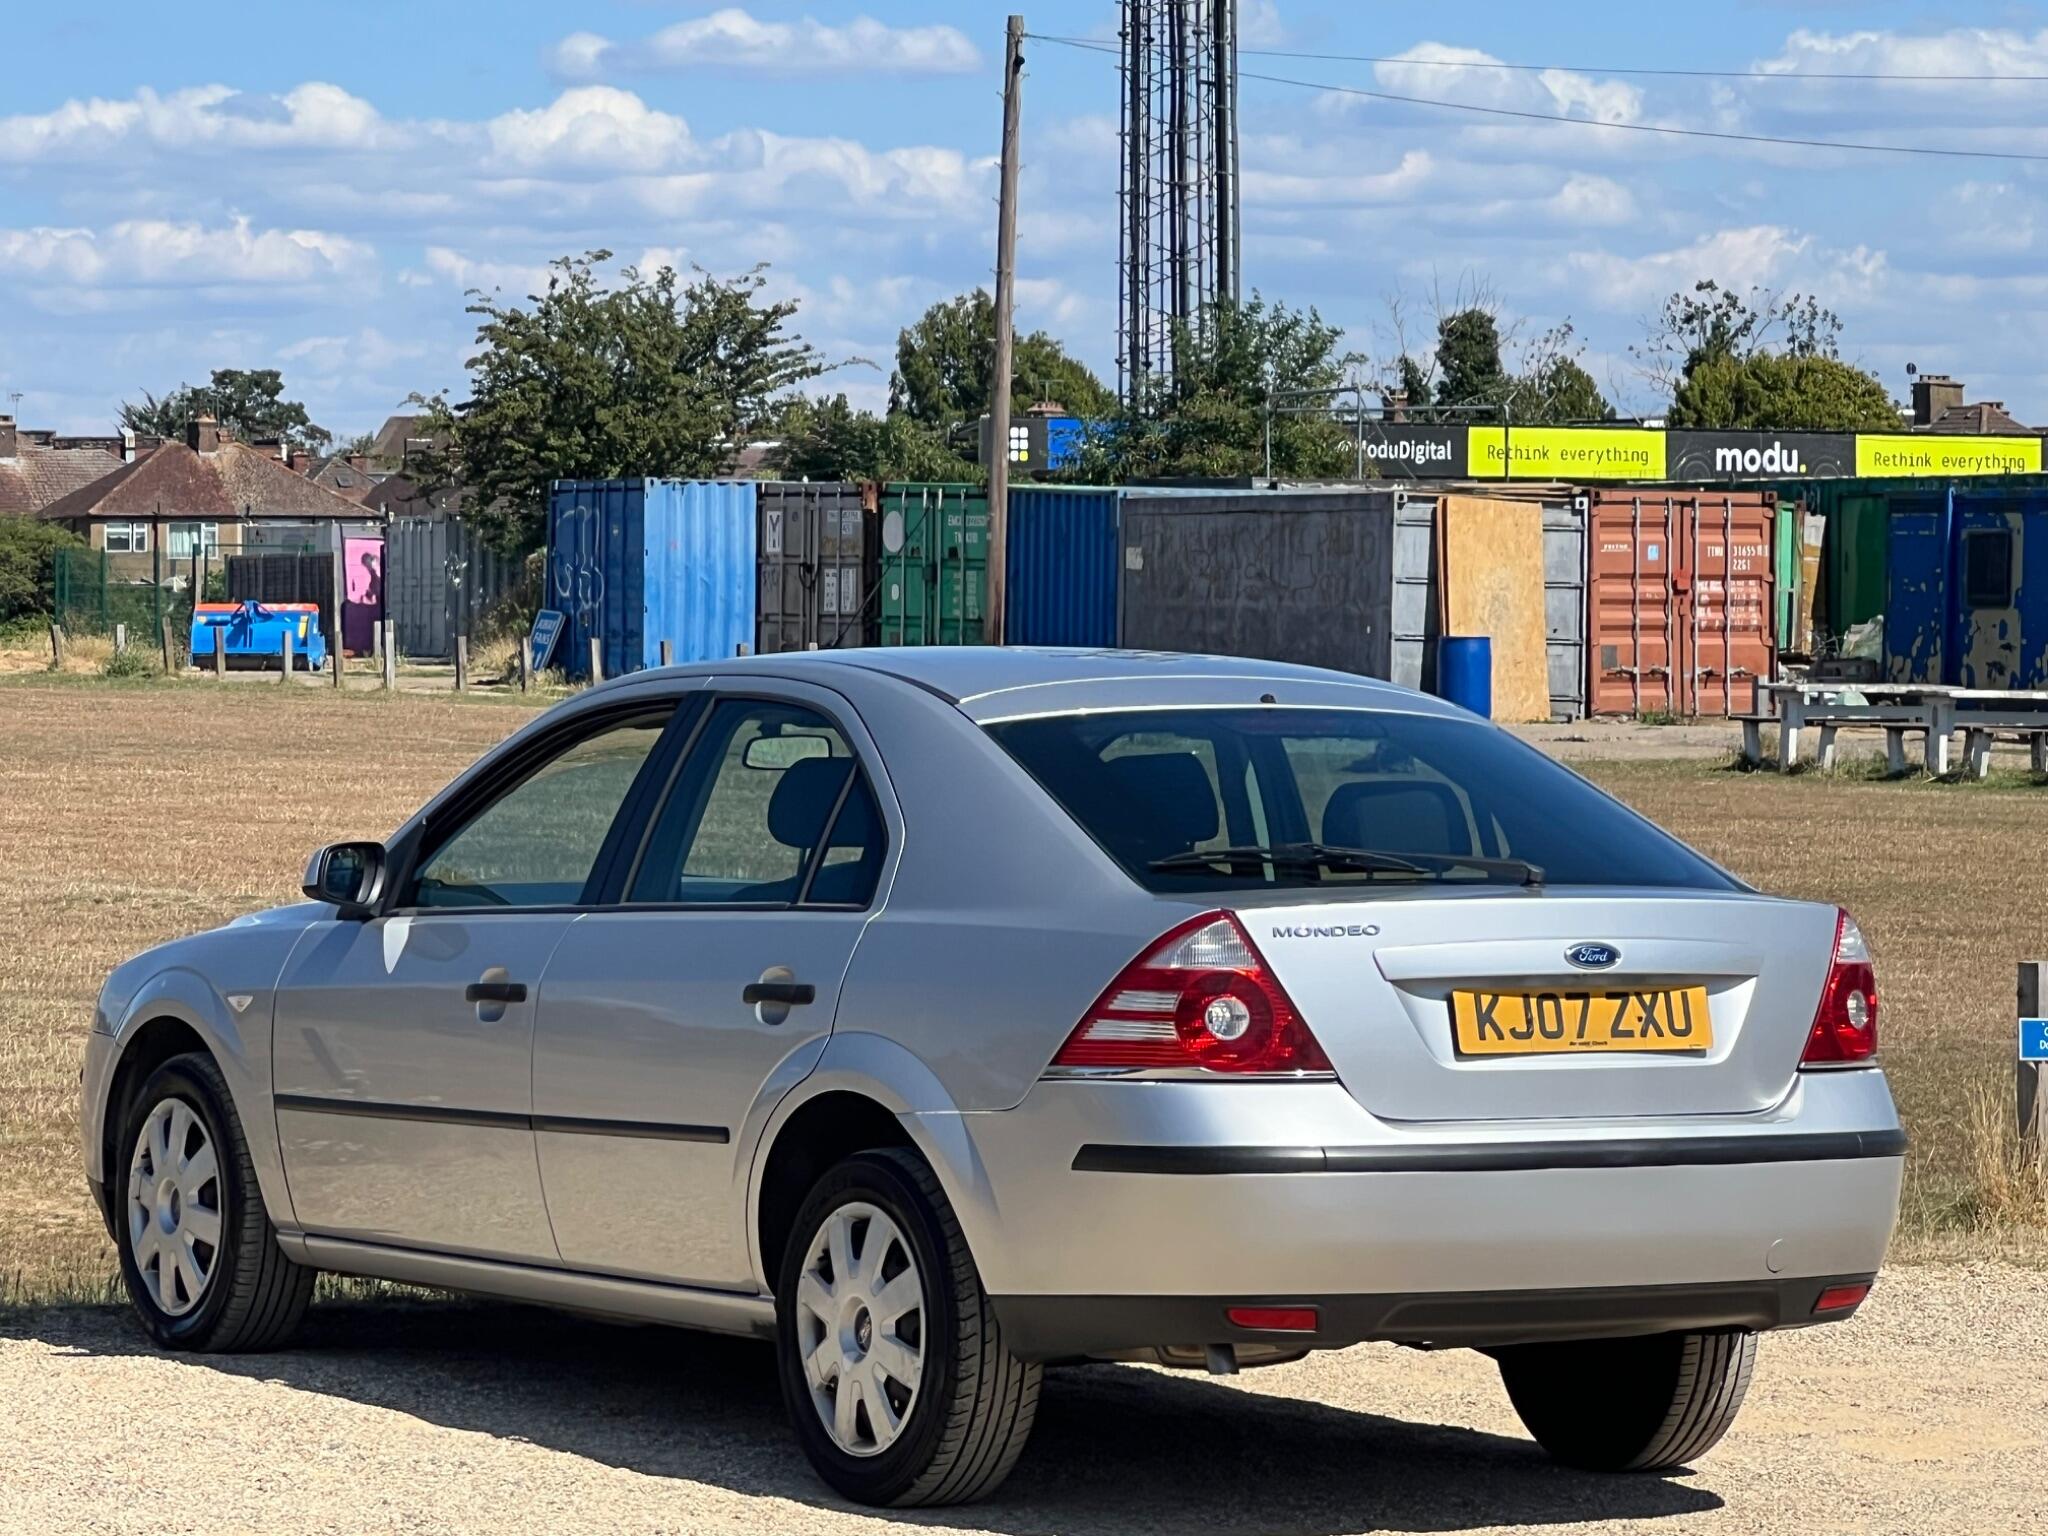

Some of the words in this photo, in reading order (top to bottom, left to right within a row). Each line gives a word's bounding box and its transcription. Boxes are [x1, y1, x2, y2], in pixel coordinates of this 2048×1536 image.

[1487, 444, 1550, 461] Rethink
[1560, 446, 1649, 466] everything
[1874, 452, 1932, 468] Rethink
[1941, 452, 2026, 471] everything
[1272, 925, 1380, 938] MONDEO
[1579, 947, 1608, 961] Ford
[1474, 992, 1591, 1041] KJ07
[1605, 991, 1692, 1039] ZXU
